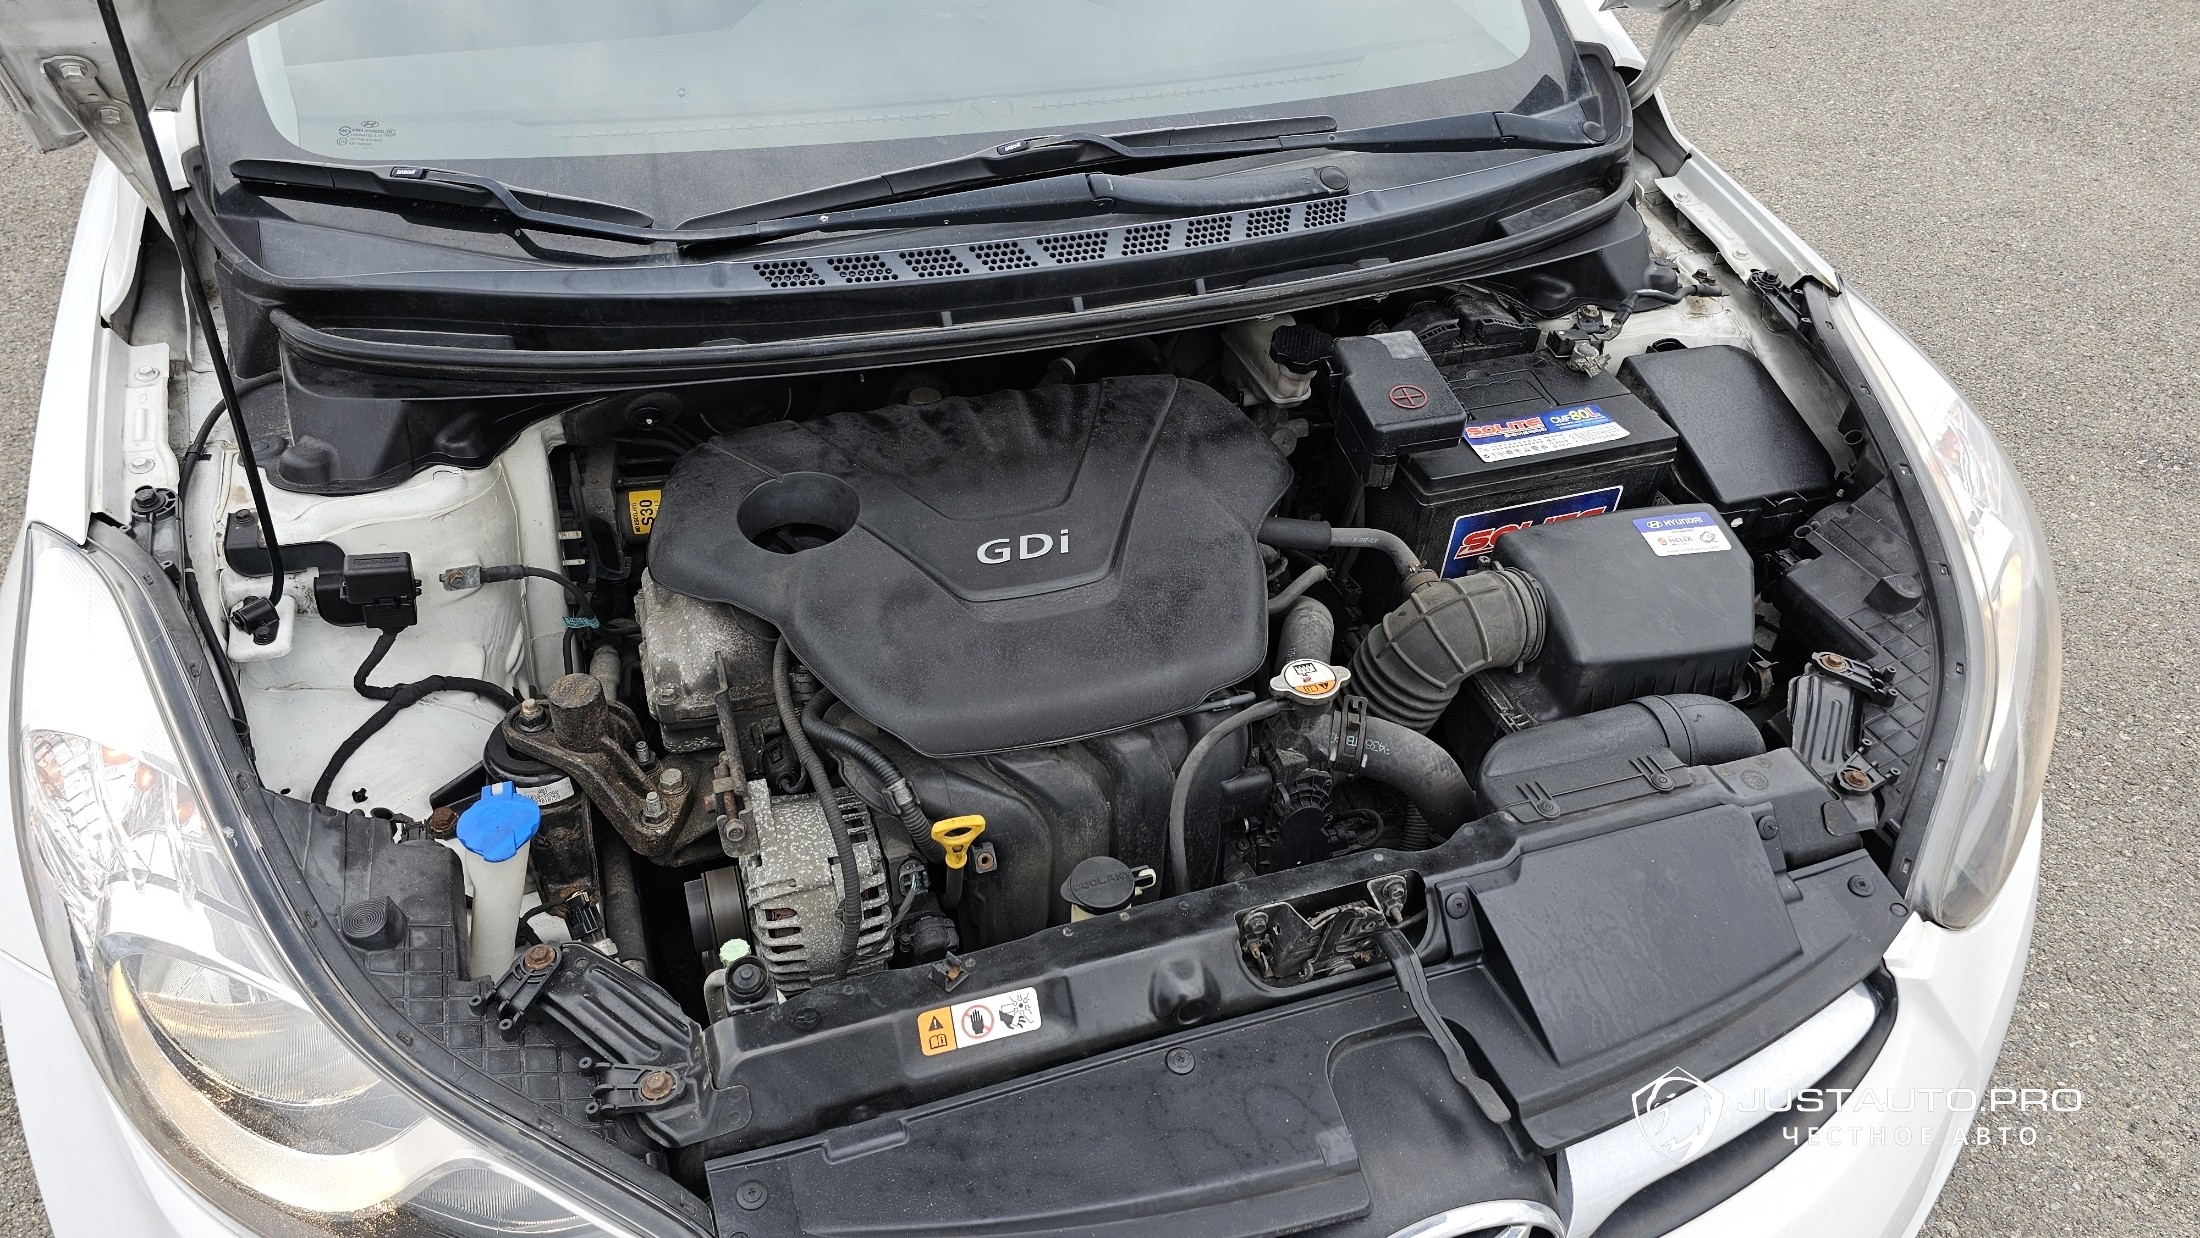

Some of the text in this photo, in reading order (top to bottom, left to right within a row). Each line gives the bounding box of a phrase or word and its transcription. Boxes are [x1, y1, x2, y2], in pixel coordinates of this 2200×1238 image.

[1465, 416, 1545, 438] SOLITE
[640, 500, 654, 526] S30
[1663, 517, 1703, 526] HYUNDAI
[976, 528, 1069, 565] GDi
[1073, 871, 1130, 892] COOLANT
